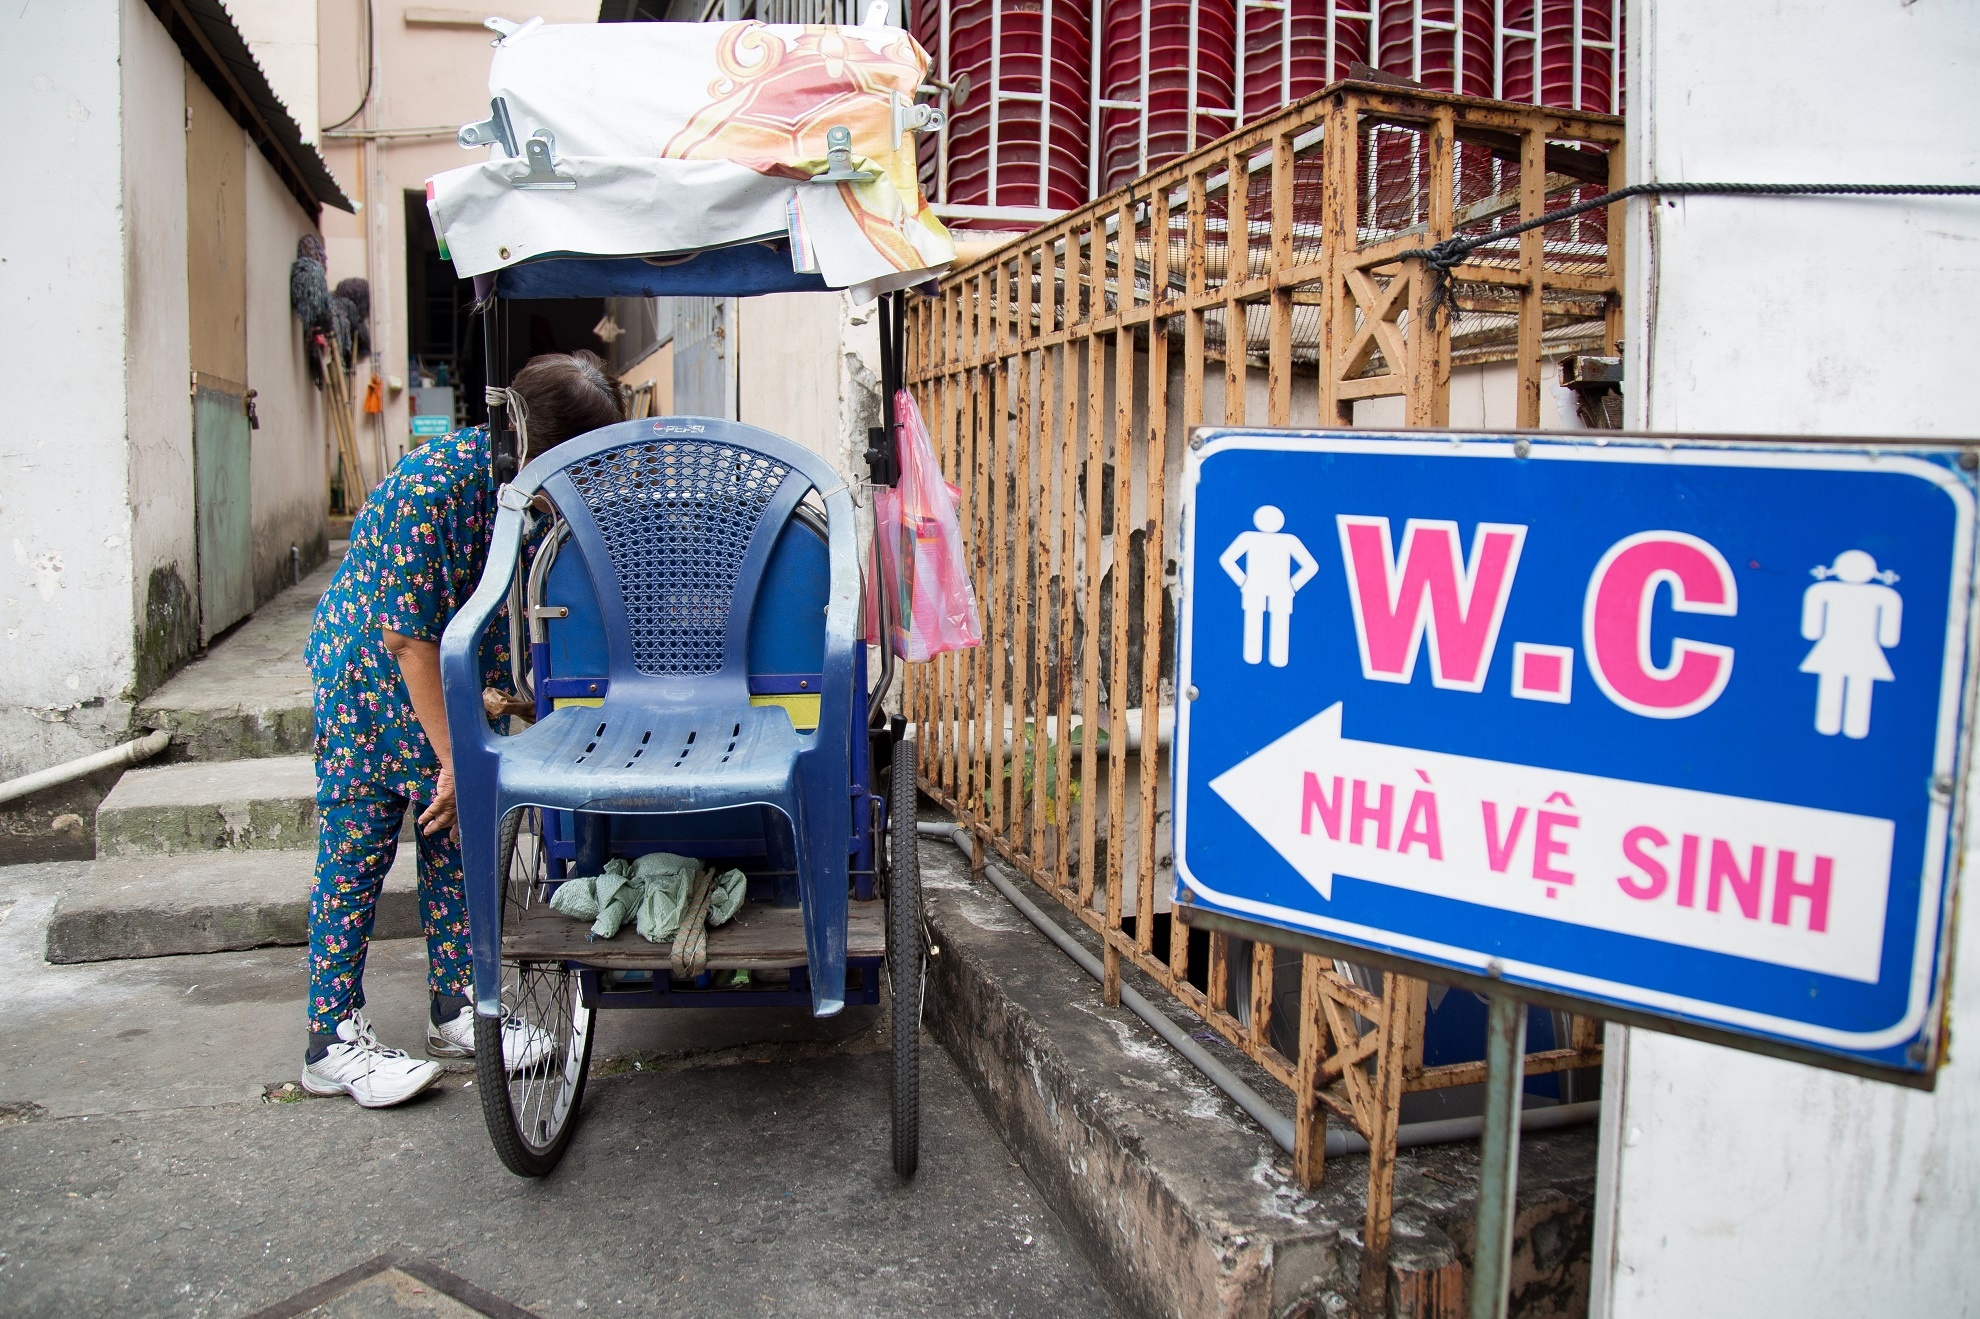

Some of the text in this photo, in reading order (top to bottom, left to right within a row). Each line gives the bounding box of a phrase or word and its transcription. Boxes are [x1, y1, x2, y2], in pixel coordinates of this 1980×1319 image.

[1337, 515, 1737, 718] W.C
[1301, 769, 1834, 933] NHÀ VỆ SINH
